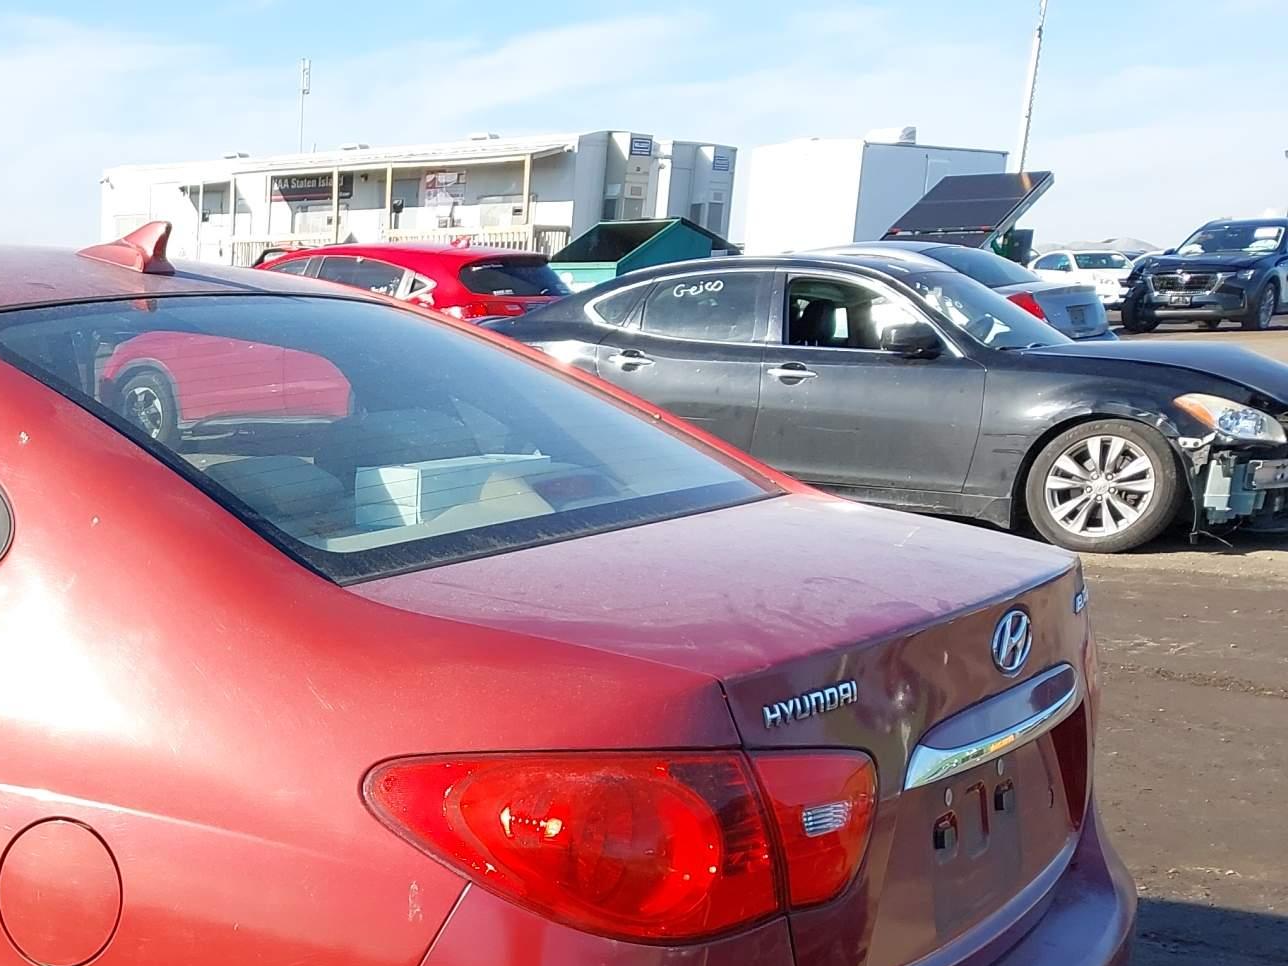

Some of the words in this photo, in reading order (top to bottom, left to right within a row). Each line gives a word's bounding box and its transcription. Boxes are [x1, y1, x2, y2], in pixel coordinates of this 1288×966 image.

[291, 177, 317, 189] Staten
[318, 175, 344, 187] Islad
[673, 280, 724, 298] Geico
[763, 680, 858, 728] HYUNDAI
